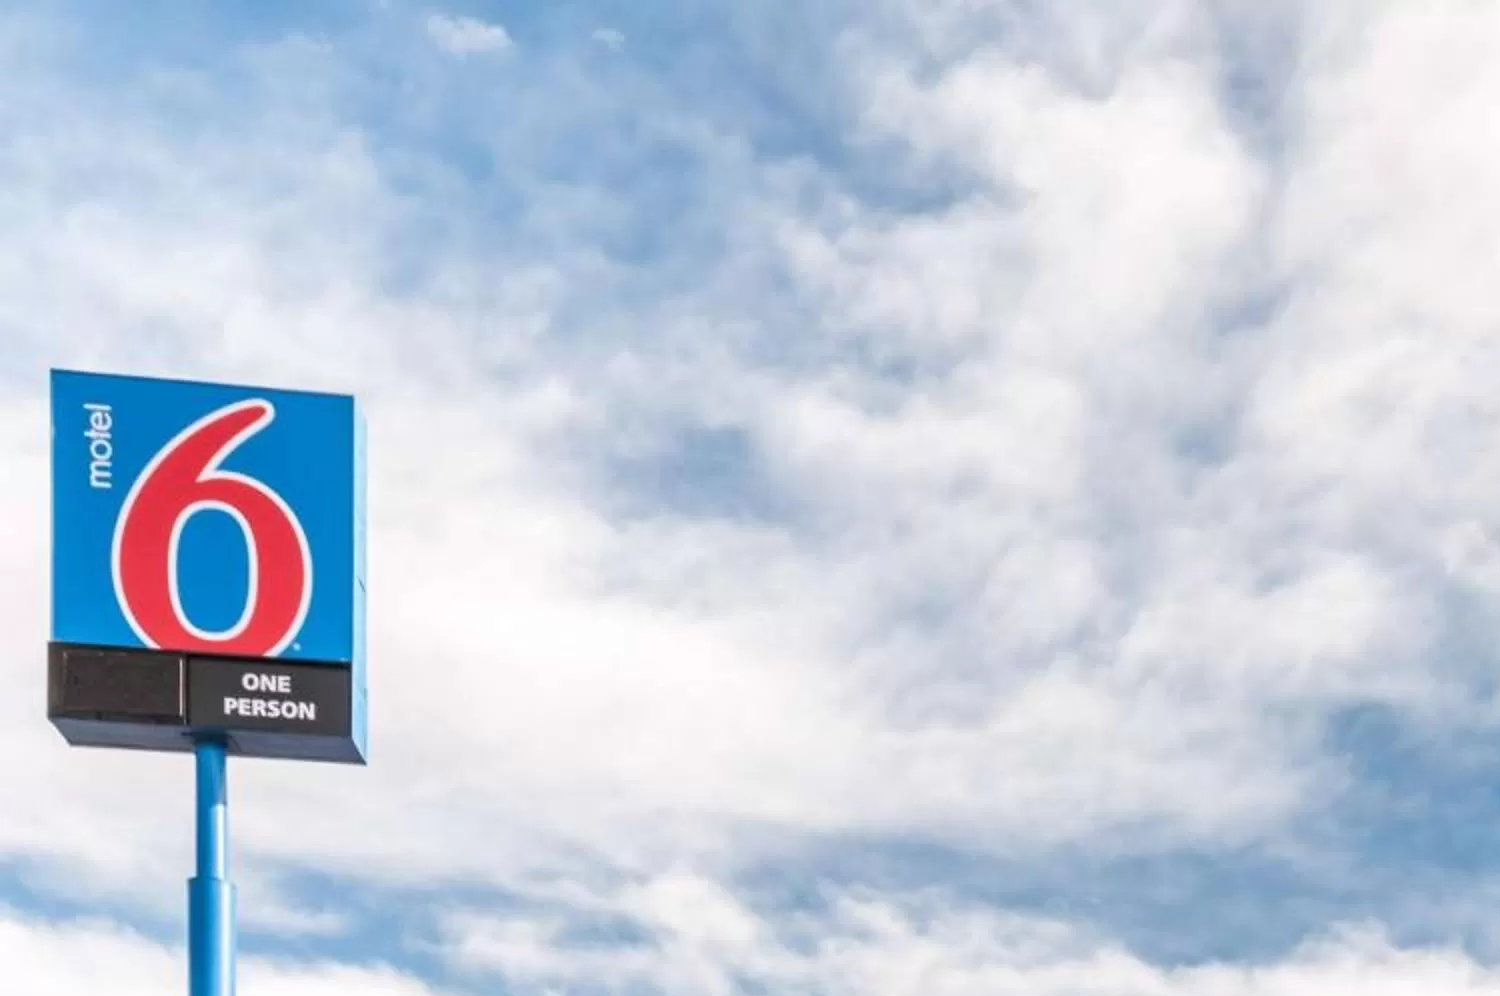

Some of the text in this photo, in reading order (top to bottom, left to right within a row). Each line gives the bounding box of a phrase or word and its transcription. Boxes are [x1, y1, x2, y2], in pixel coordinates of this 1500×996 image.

[82, 403, 113, 489] motel
[111, 397, 313, 658] 6
[223, 696, 316, 720] PERSON
[241, 672, 292, 693] ONE
